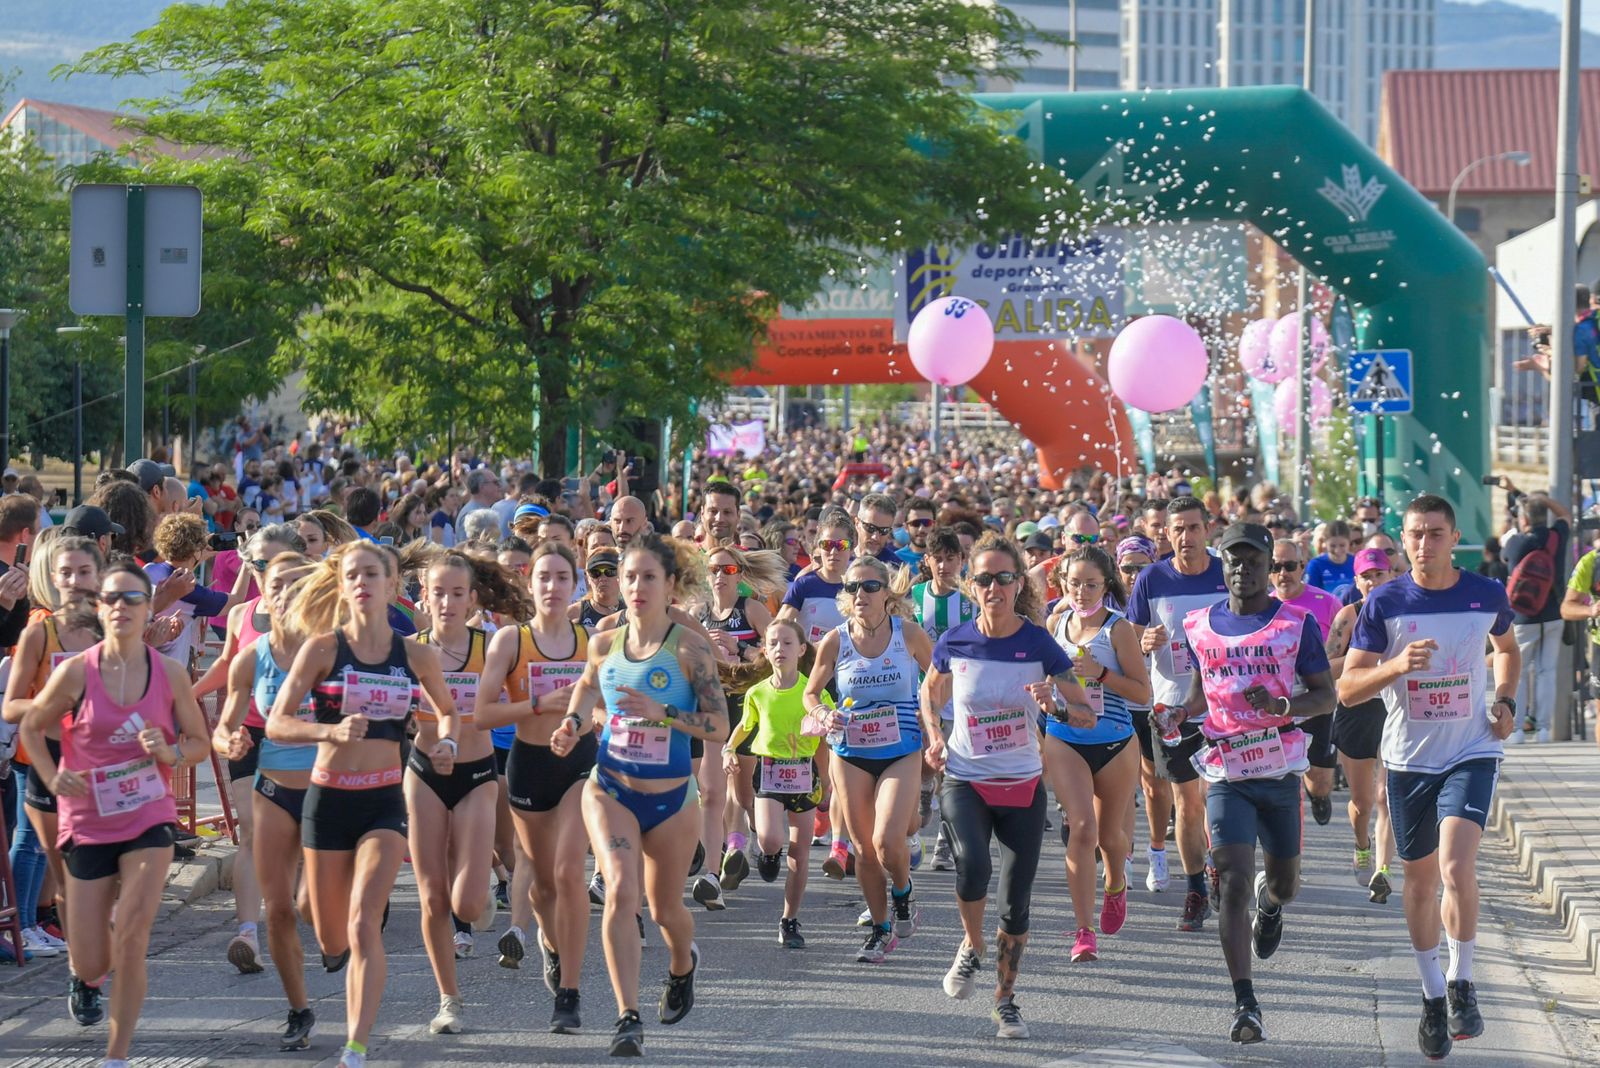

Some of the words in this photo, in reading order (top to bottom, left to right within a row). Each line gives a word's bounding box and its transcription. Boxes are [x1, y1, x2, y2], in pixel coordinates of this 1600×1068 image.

[971, 265, 1053, 281] deports
[975, 297, 1114, 332] ALIDA
[1205, 648, 1221, 660] TU
[1226, 645, 1273, 658] LUCHA
[542, 666, 584, 674] COVIRA
[1220, 665, 1235, 678] MI
[358, 677, 408, 689] COVIRAN
[445, 677, 476, 685] VIRAN
[847, 672, 902, 686] MARACENA
[1419, 678, 1469, 690] COVIRAN
[369, 689, 388, 703] 141
[1429, 692, 1450, 705] 512
[853, 709, 896, 721] COVIRAN
[978, 710, 1025, 724] COVIRAN
[861, 722, 881, 734] 482
[985, 724, 1012, 740] 1190
[867, 736, 888, 744] vithas
[1231, 732, 1277, 749] COVIRAN
[994, 742, 1017, 752] vithas
[773, 757, 811, 765] COVIRAN
[1240, 747, 1265, 764] 1179
[778, 768, 797, 779] 265
[1250, 763, 1273, 774] vithas
[337, 773, 379, 785] NIKE
[118, 777, 140, 795] 527
